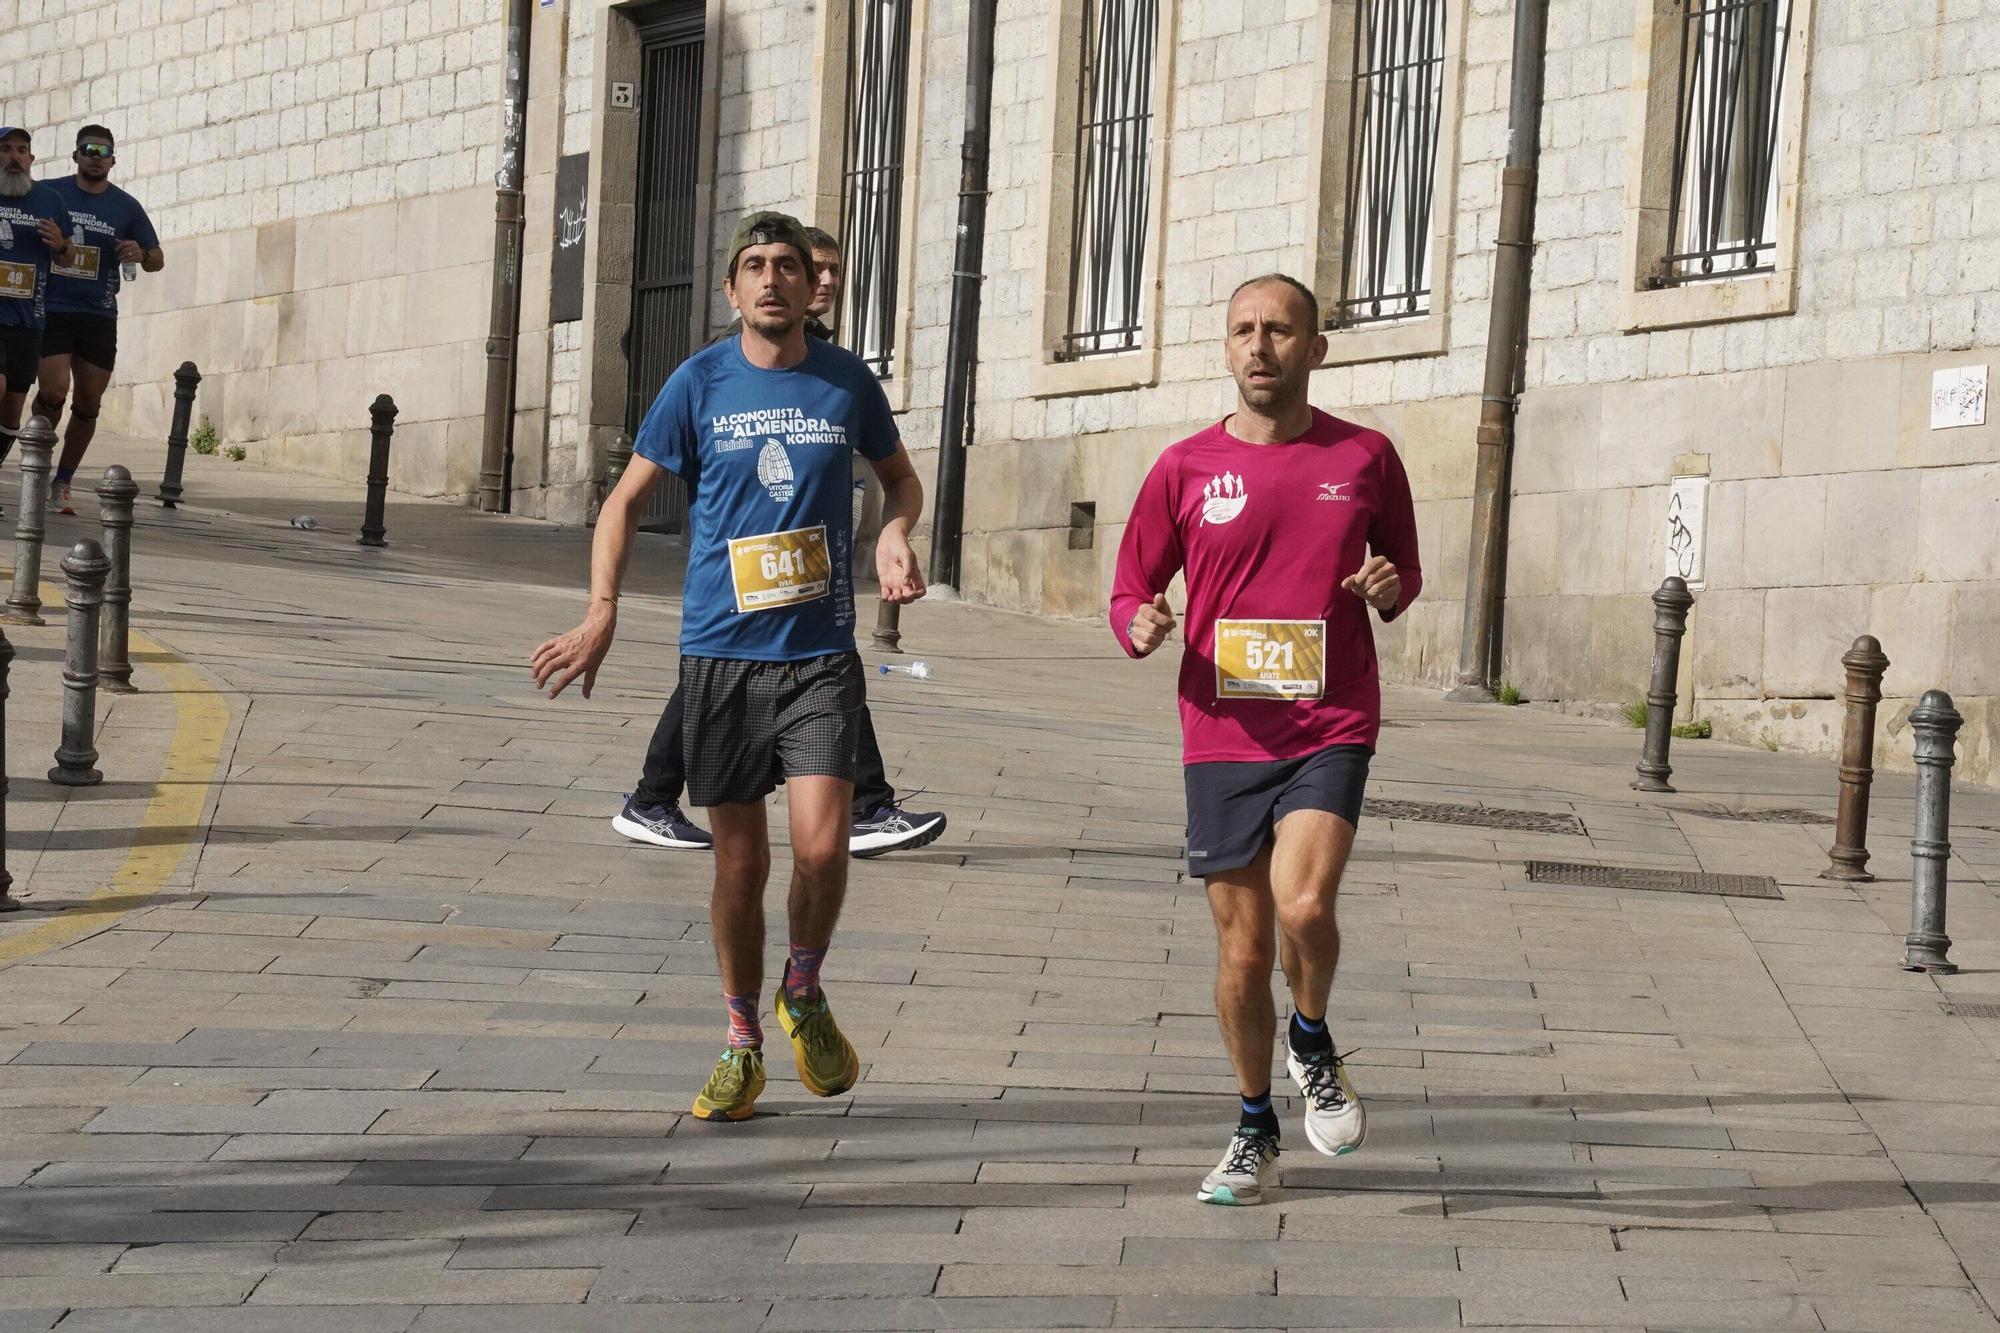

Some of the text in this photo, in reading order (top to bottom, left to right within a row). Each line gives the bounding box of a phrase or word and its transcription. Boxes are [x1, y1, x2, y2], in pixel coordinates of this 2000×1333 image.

[8, 271, 23, 285] 48
[713, 408, 804, 426] LA CONQUISTA
[713, 426, 724, 434] DE
[733, 418, 832, 439] ALMENDRA
[831, 425, 845, 433] REN
[786, 433, 847, 445] KONKISTA
[761, 548, 805, 580] 641
[1304, 629, 1318, 637] 10K
[1246, 640, 1293, 670] 521
